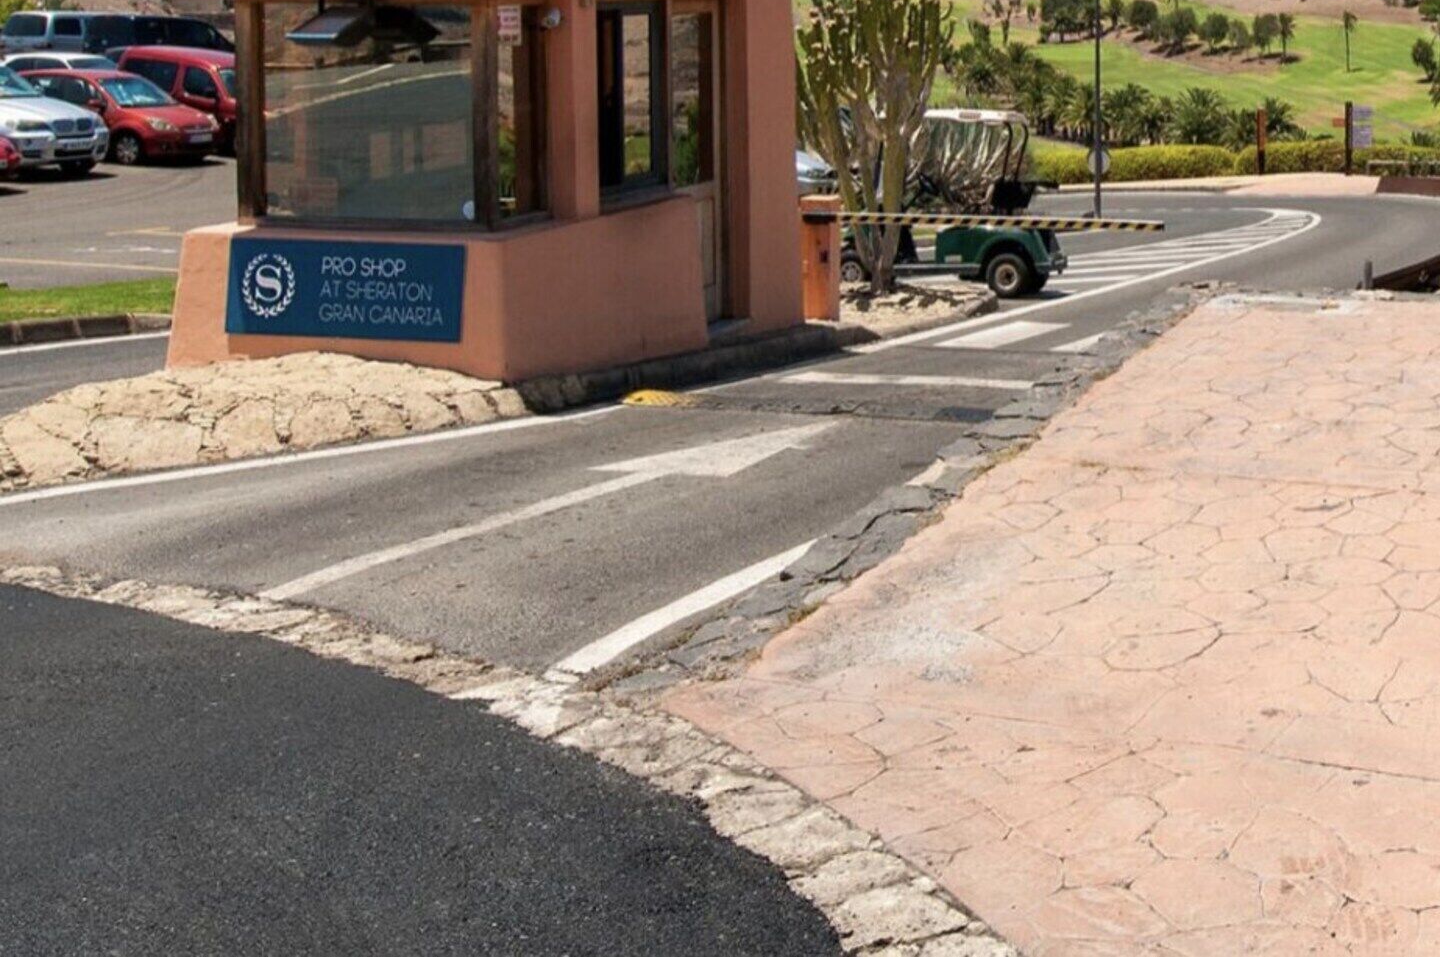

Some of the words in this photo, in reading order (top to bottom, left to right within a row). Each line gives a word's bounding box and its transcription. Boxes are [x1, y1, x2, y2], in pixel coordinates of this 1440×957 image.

[321, 256, 356, 276] PRO
[360, 257, 407, 278] SHOP
[320, 280, 341, 298] AT
[345, 280, 433, 302] SHERATON
[318, 303, 366, 323] GRAN
[369, 304, 443, 325] CANARIA
